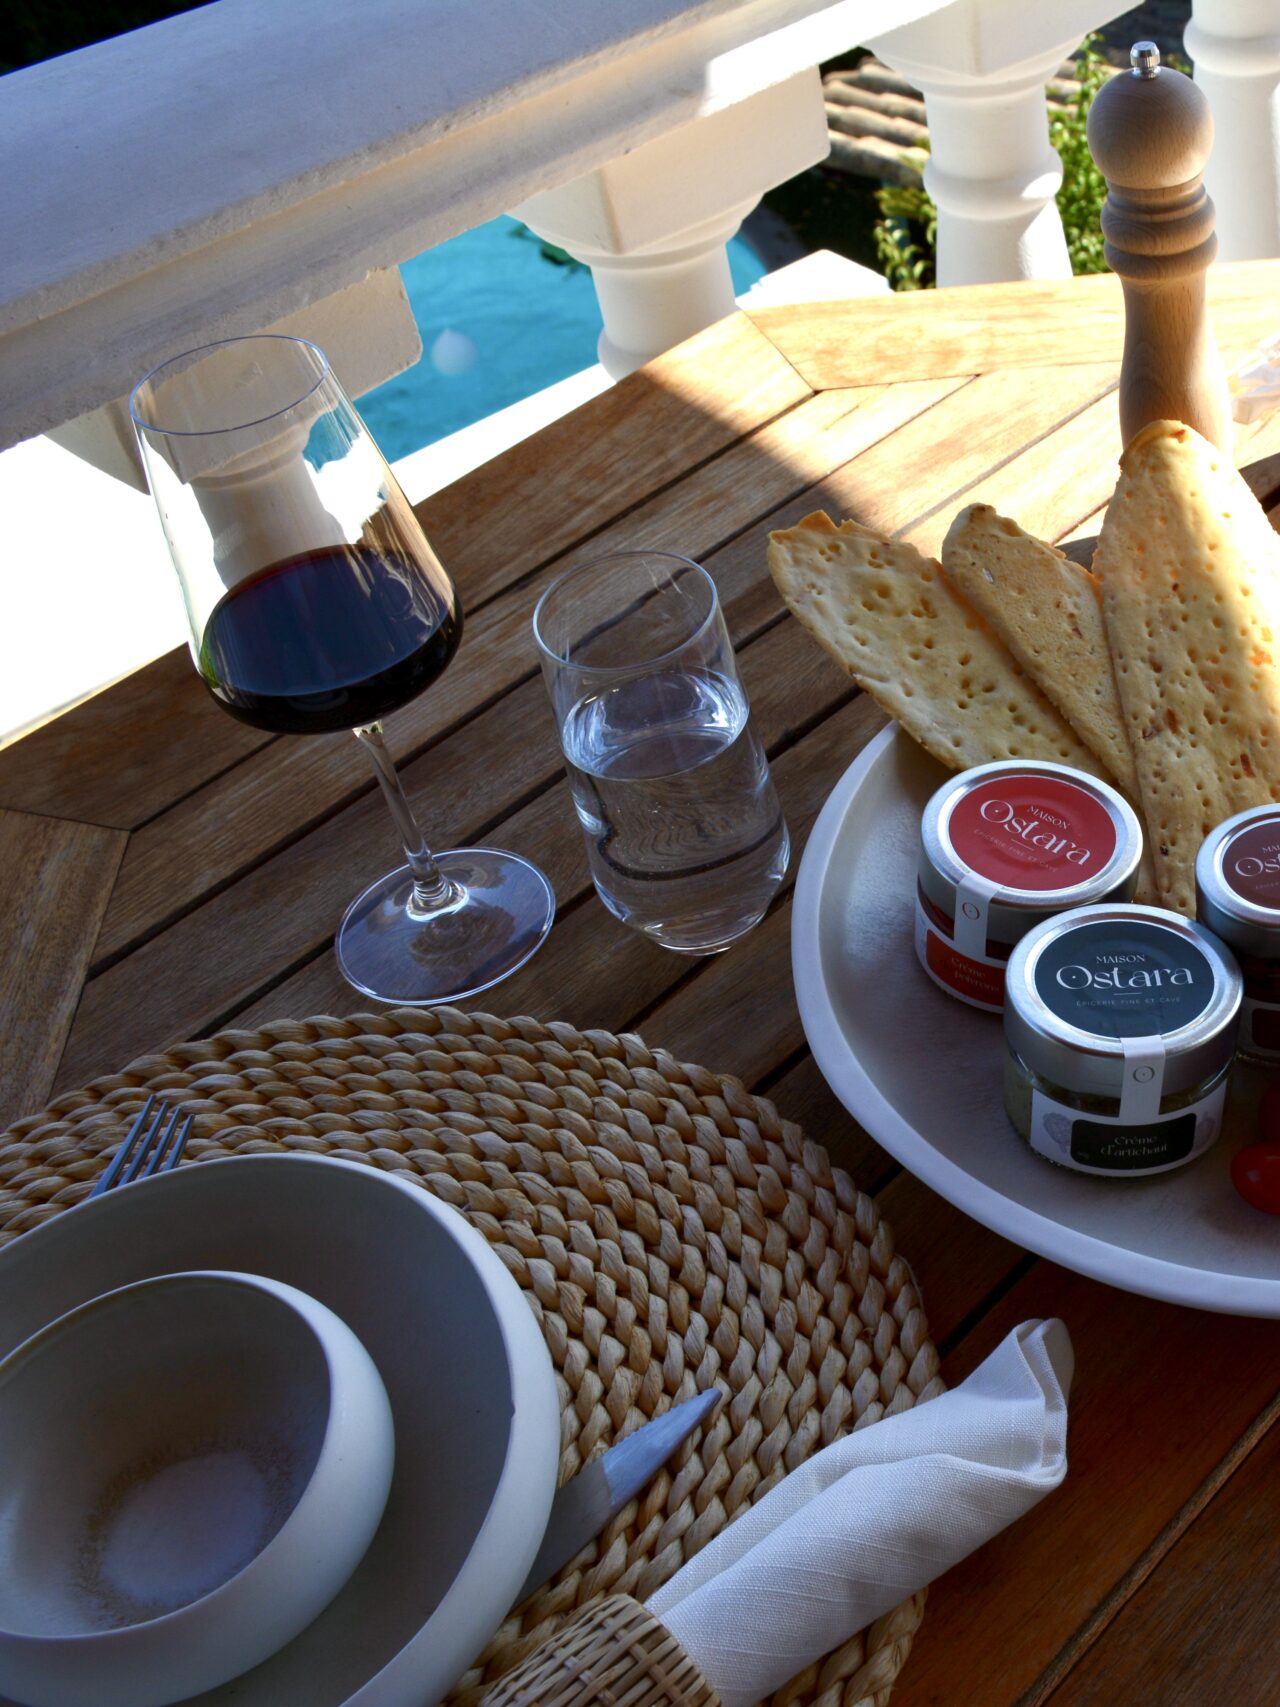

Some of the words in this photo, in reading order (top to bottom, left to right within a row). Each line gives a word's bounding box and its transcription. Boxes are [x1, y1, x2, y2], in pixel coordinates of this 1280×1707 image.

[1027, 805, 1071, 830] MAISON
[980, 799, 1091, 865] Ostara
[1096, 954, 1146, 964] MAISON
[1056, 965, 1194, 990] Ostara
